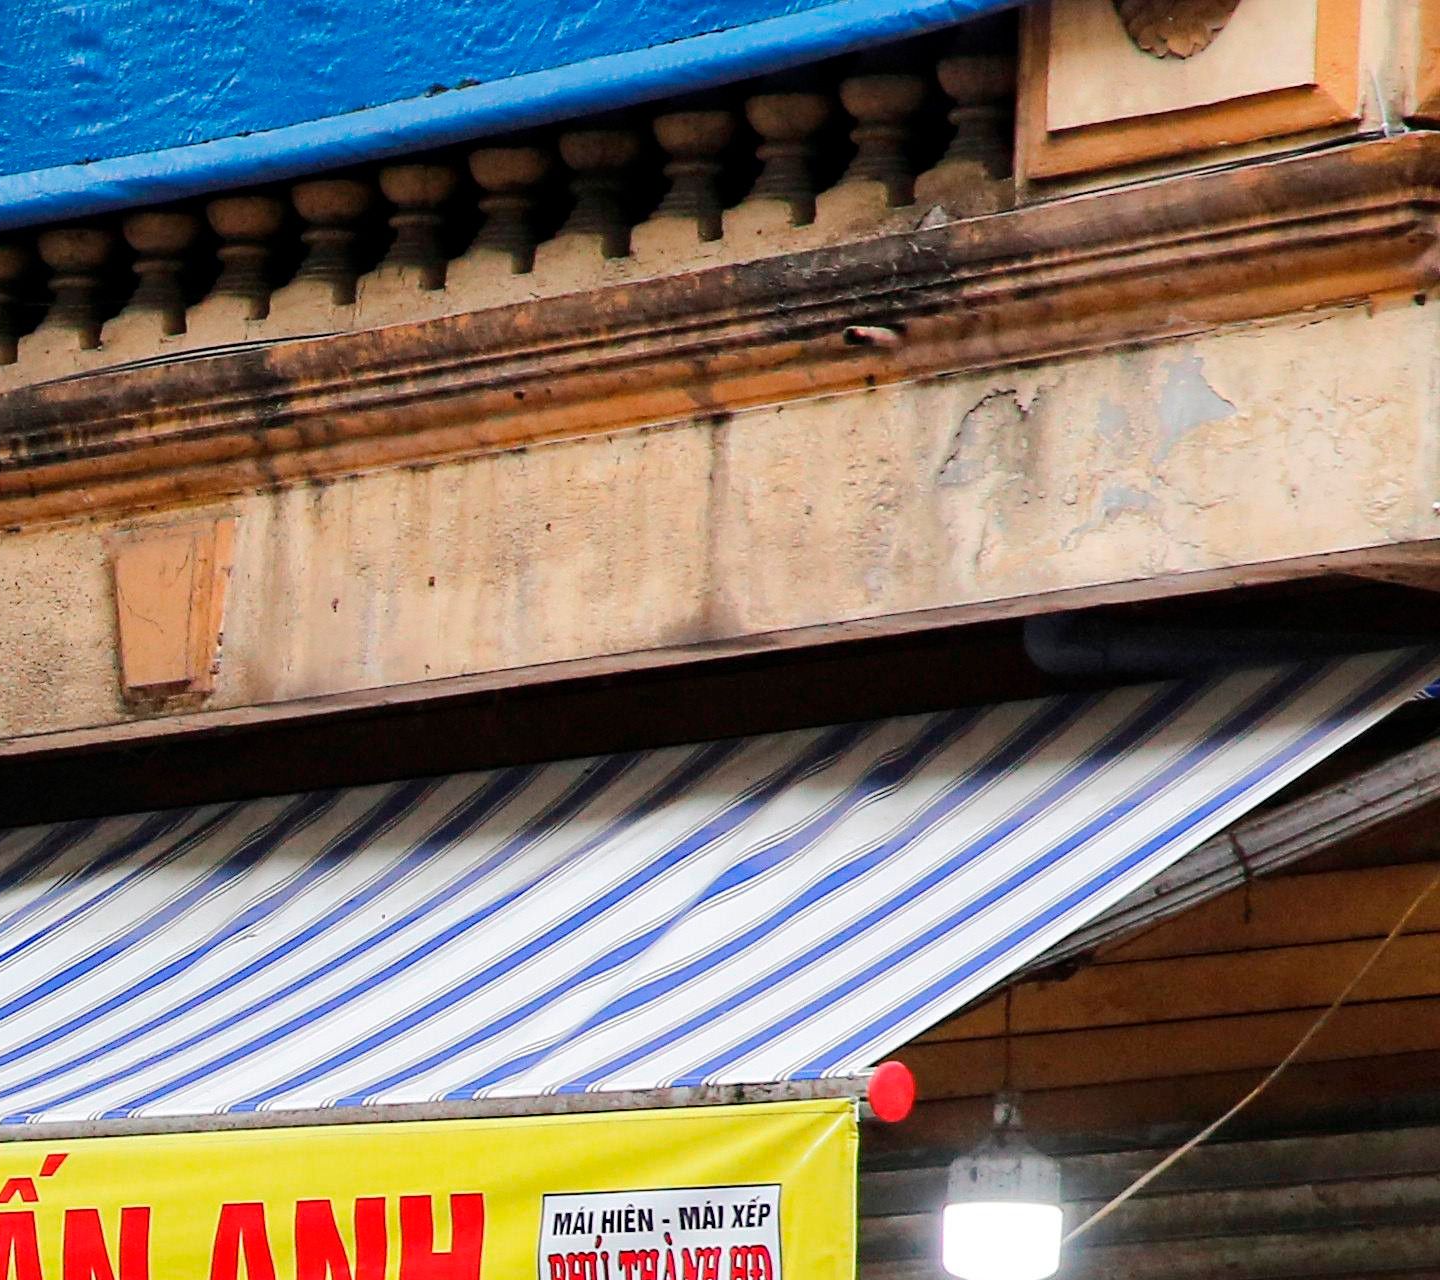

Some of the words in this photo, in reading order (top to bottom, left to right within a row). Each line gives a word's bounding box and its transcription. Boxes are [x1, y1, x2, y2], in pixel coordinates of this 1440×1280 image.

[553, 1206, 594, 1236] MÁI
[602, 1203, 654, 1234] HIÊN
[679, 1201, 724, 1231] MÁI
[732, 1196, 772, 1228] XẾP
